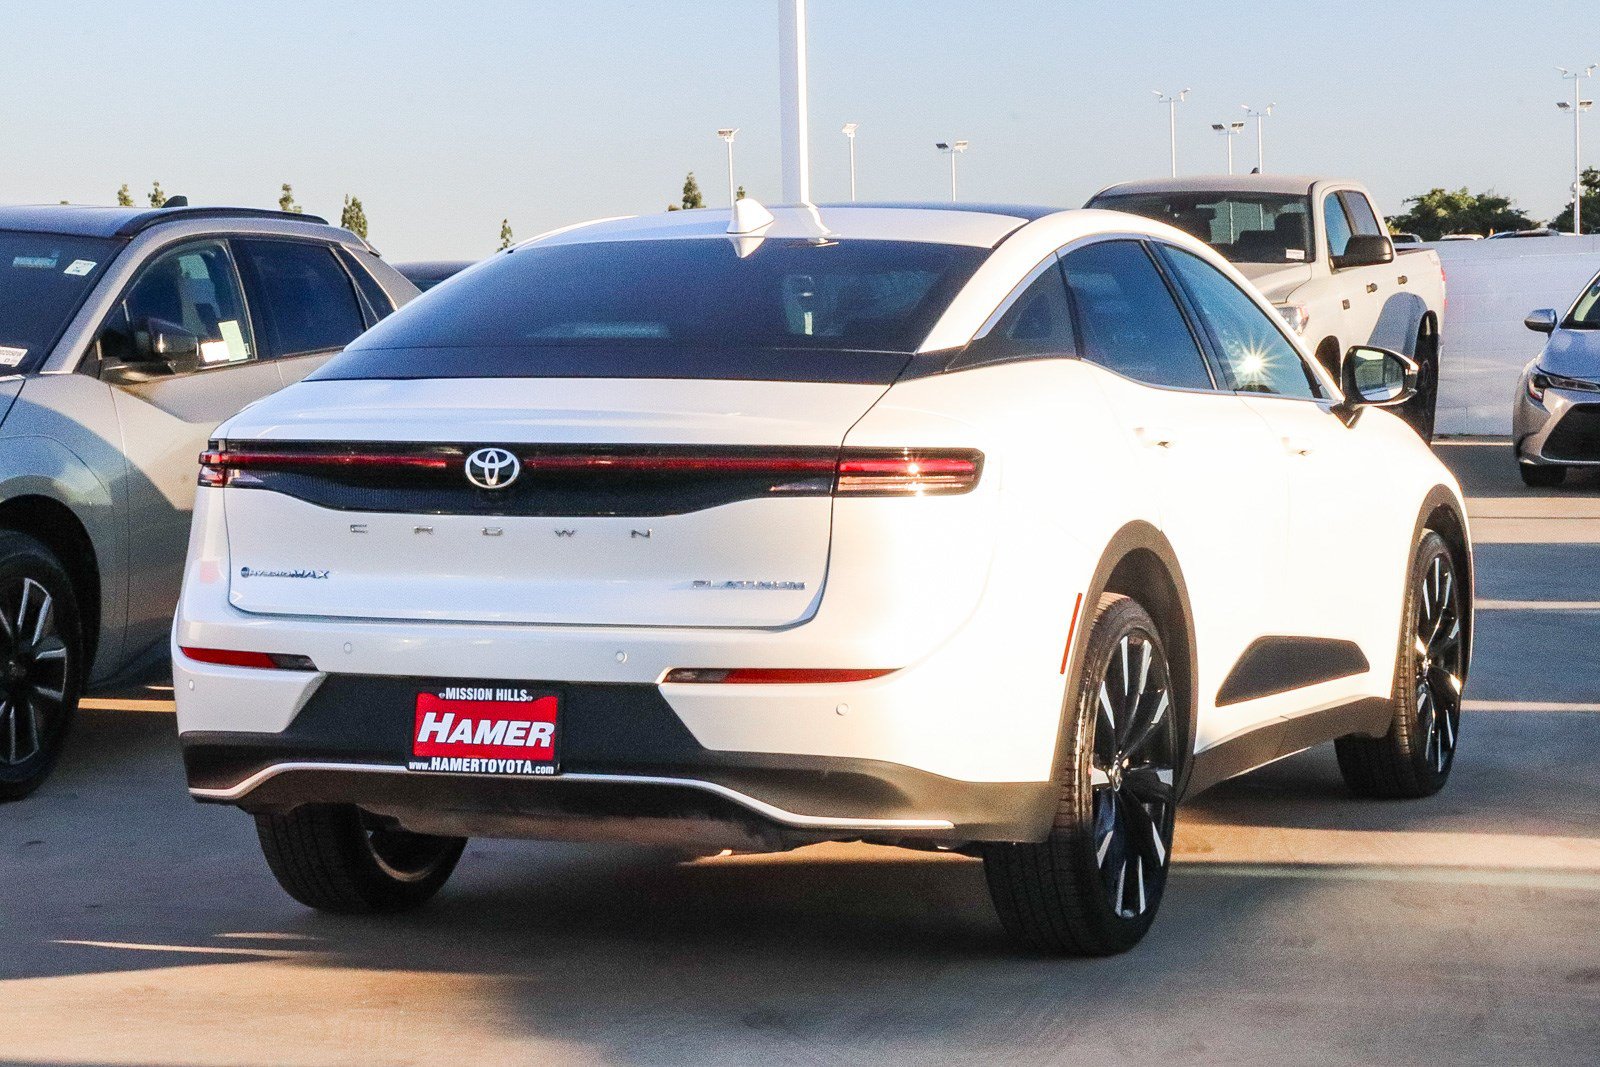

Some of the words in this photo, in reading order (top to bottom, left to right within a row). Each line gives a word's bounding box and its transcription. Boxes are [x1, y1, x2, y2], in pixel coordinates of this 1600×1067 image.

[349, 523, 652, 539] CROWN
[445, 687, 493, 701] MISSION
[496, 688, 528, 702] HILLS
[416, 711, 555, 748] HAMER
[408, 757, 555, 775] www.HAMERTOYOTA.com
